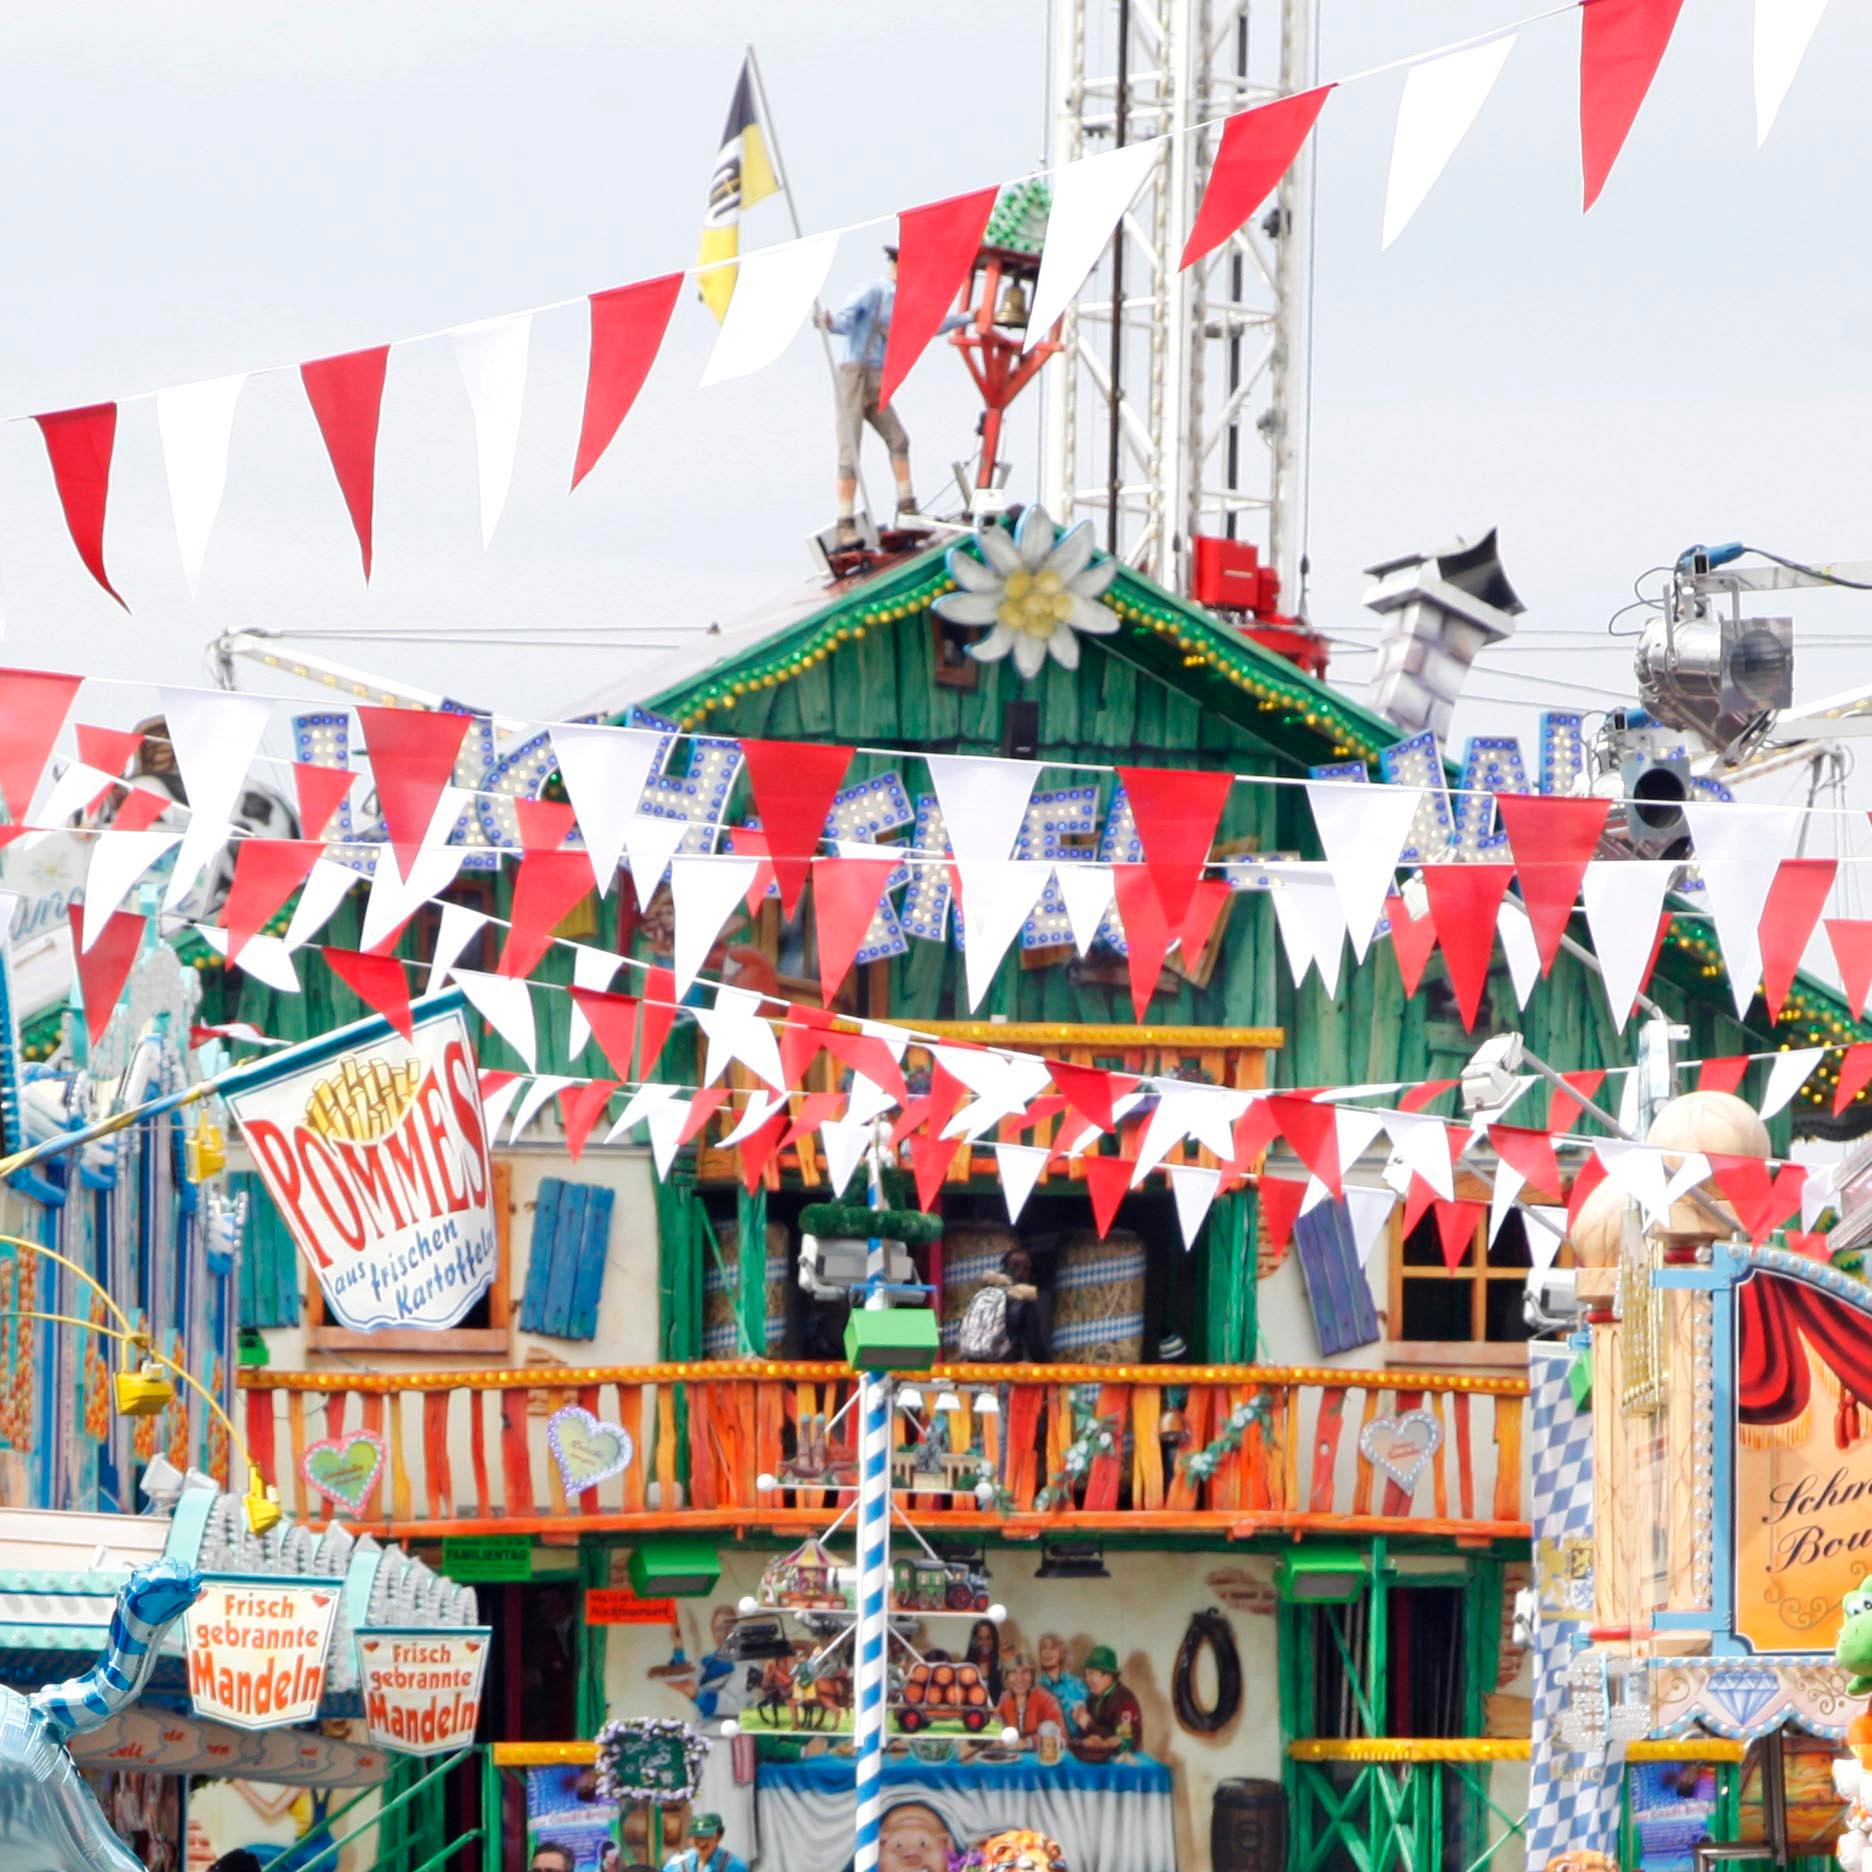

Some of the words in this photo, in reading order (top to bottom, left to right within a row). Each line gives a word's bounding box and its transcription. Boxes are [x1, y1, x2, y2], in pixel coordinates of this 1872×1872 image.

[243, 1040, 487, 1270] POMMES
[335, 1263, 367, 1296] aus
[370, 1219, 459, 1301] frischen
[394, 1229, 492, 1319] Kartoffeln
[224, 1592, 295, 1618] Frisch
[196, 1620, 318, 1648] gebrannte
[393, 1642, 451, 1663] Frisch
[192, 1650, 324, 1716] Mandeln
[370, 1667, 471, 1691] gebrannte
[368, 1691, 477, 1744] Mandeln
